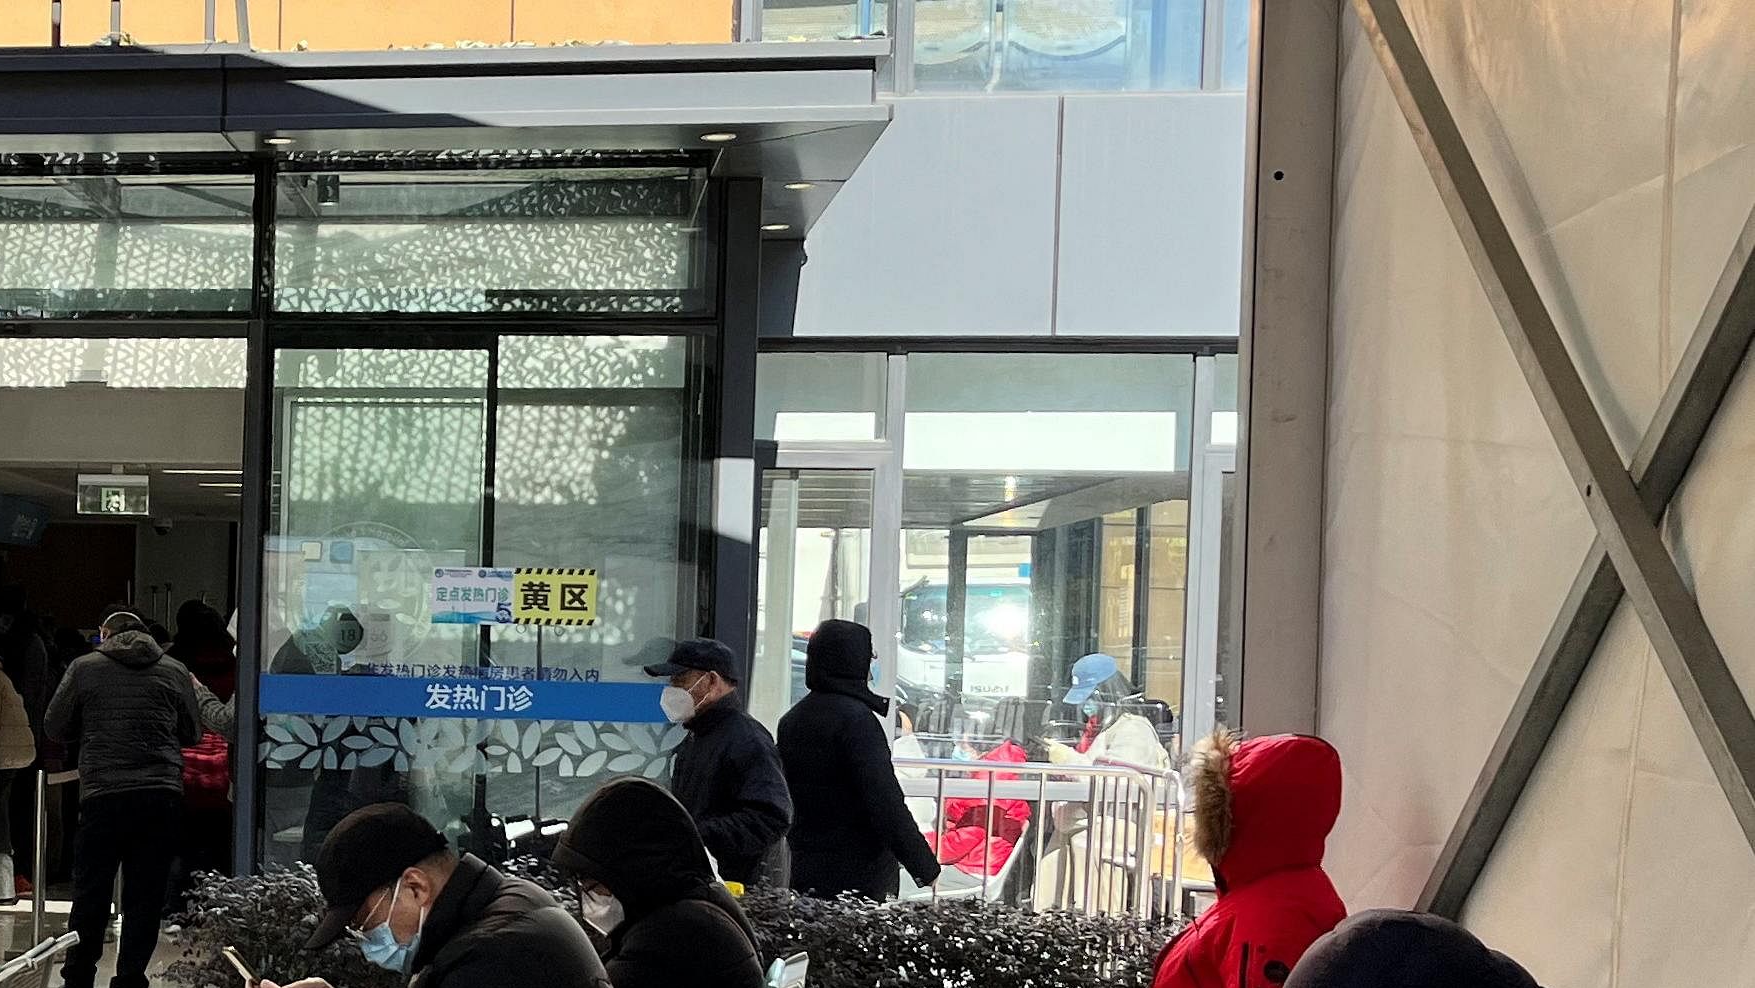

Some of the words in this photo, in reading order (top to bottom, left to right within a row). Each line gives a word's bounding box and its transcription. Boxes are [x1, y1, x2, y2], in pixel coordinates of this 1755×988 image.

[436, 586, 509, 602] 定点发热门诊
[520, 581, 589, 611] 黄区
[425, 683, 534, 713] 发热门诊
